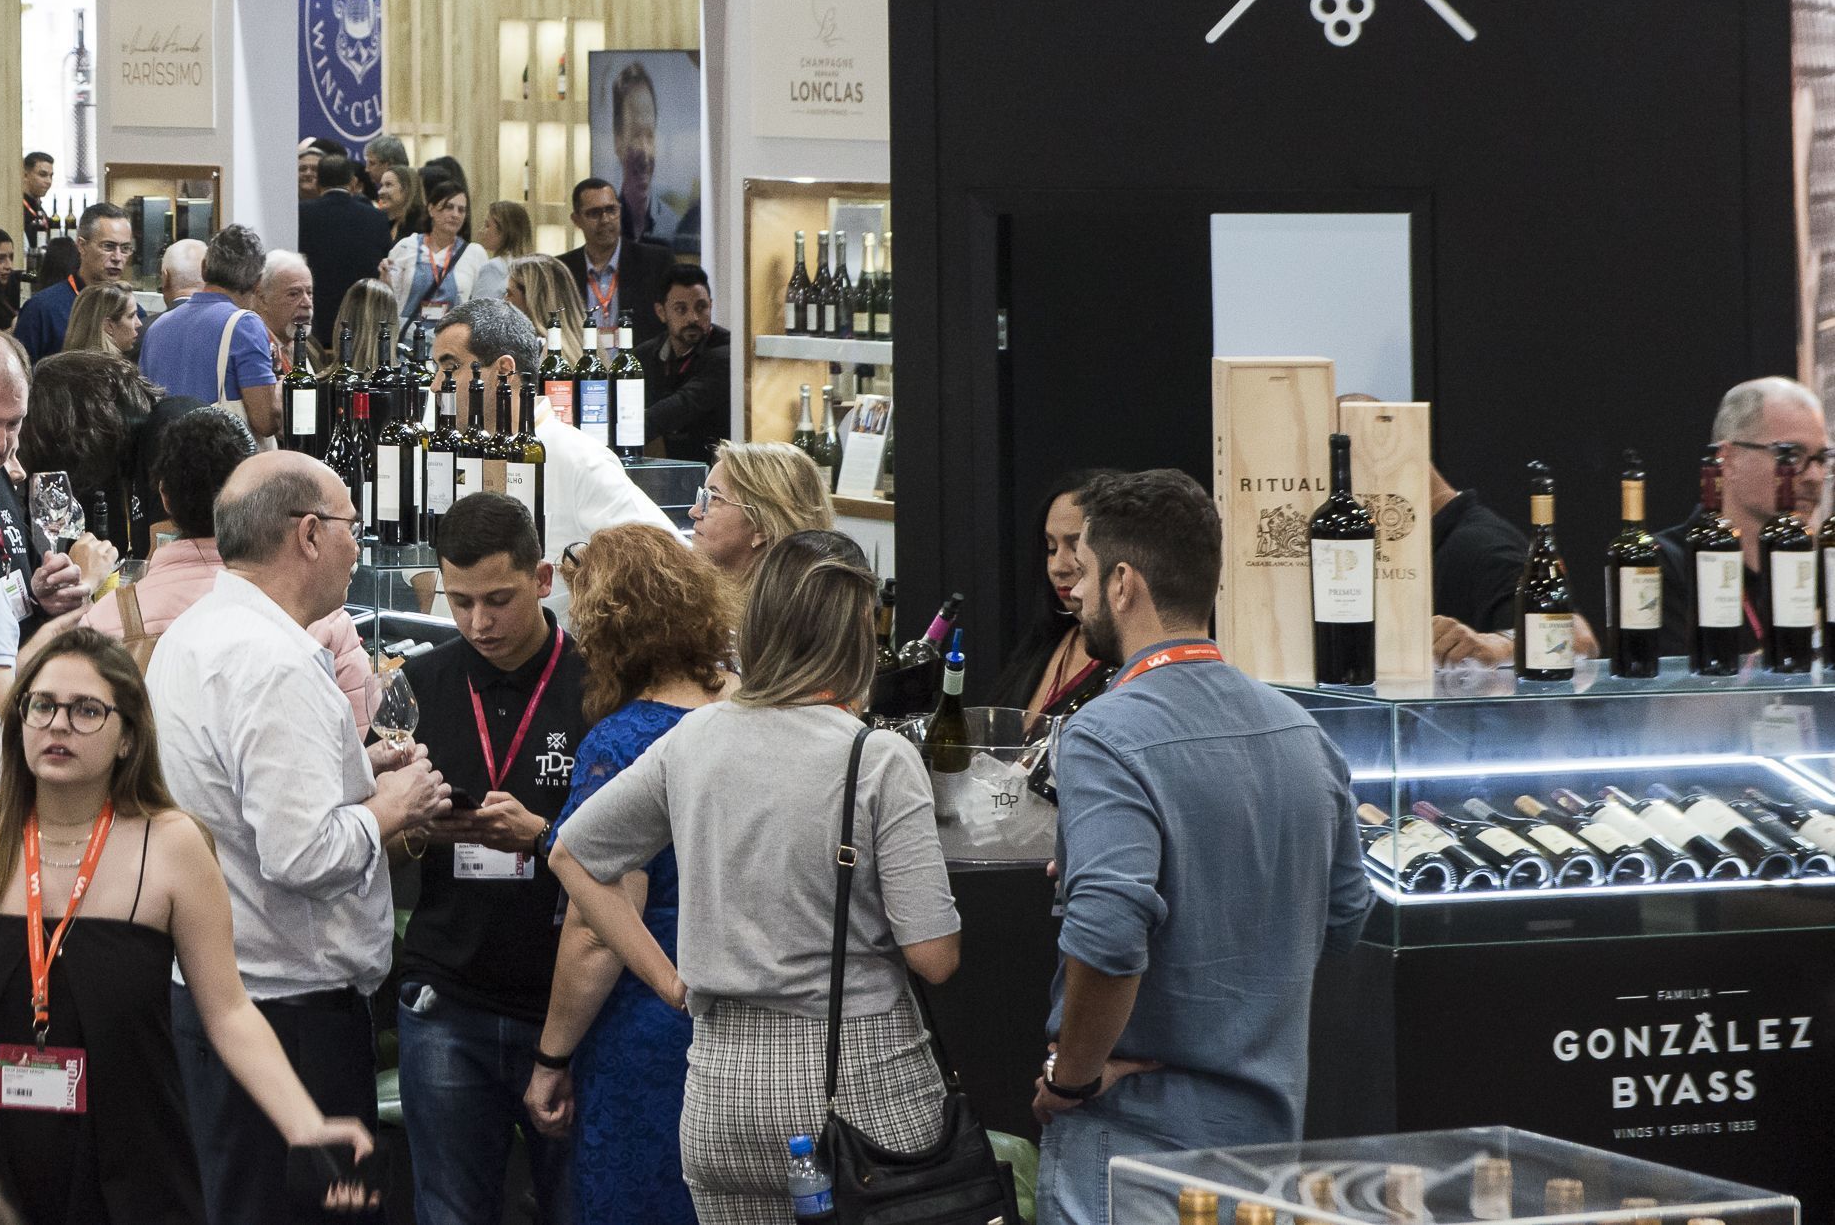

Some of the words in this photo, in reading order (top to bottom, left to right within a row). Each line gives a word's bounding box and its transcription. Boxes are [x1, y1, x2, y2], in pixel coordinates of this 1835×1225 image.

[789, 80, 864, 103] LONCLAS
[1240, 478, 1326, 492] RITUAL
[1375, 568, 1417, 580] IMUS
[535, 751, 576, 777] TDP
[535, 777, 568, 787] wine
[991, 792, 1019, 809] TDP
[1657, 988, 1712, 1001] FAMILIA
[1552, 1011, 1814, 1062] GONZÁLEZ
[1612, 1069, 1757, 1109] BYASS
[1613, 1126, 1654, 1139] VINOS
[1658, 1126, 1666, 1136] Y
[1669, 1122, 1722, 1136] SPIRITS
[1727, 1120, 1757, 1132] 1835
